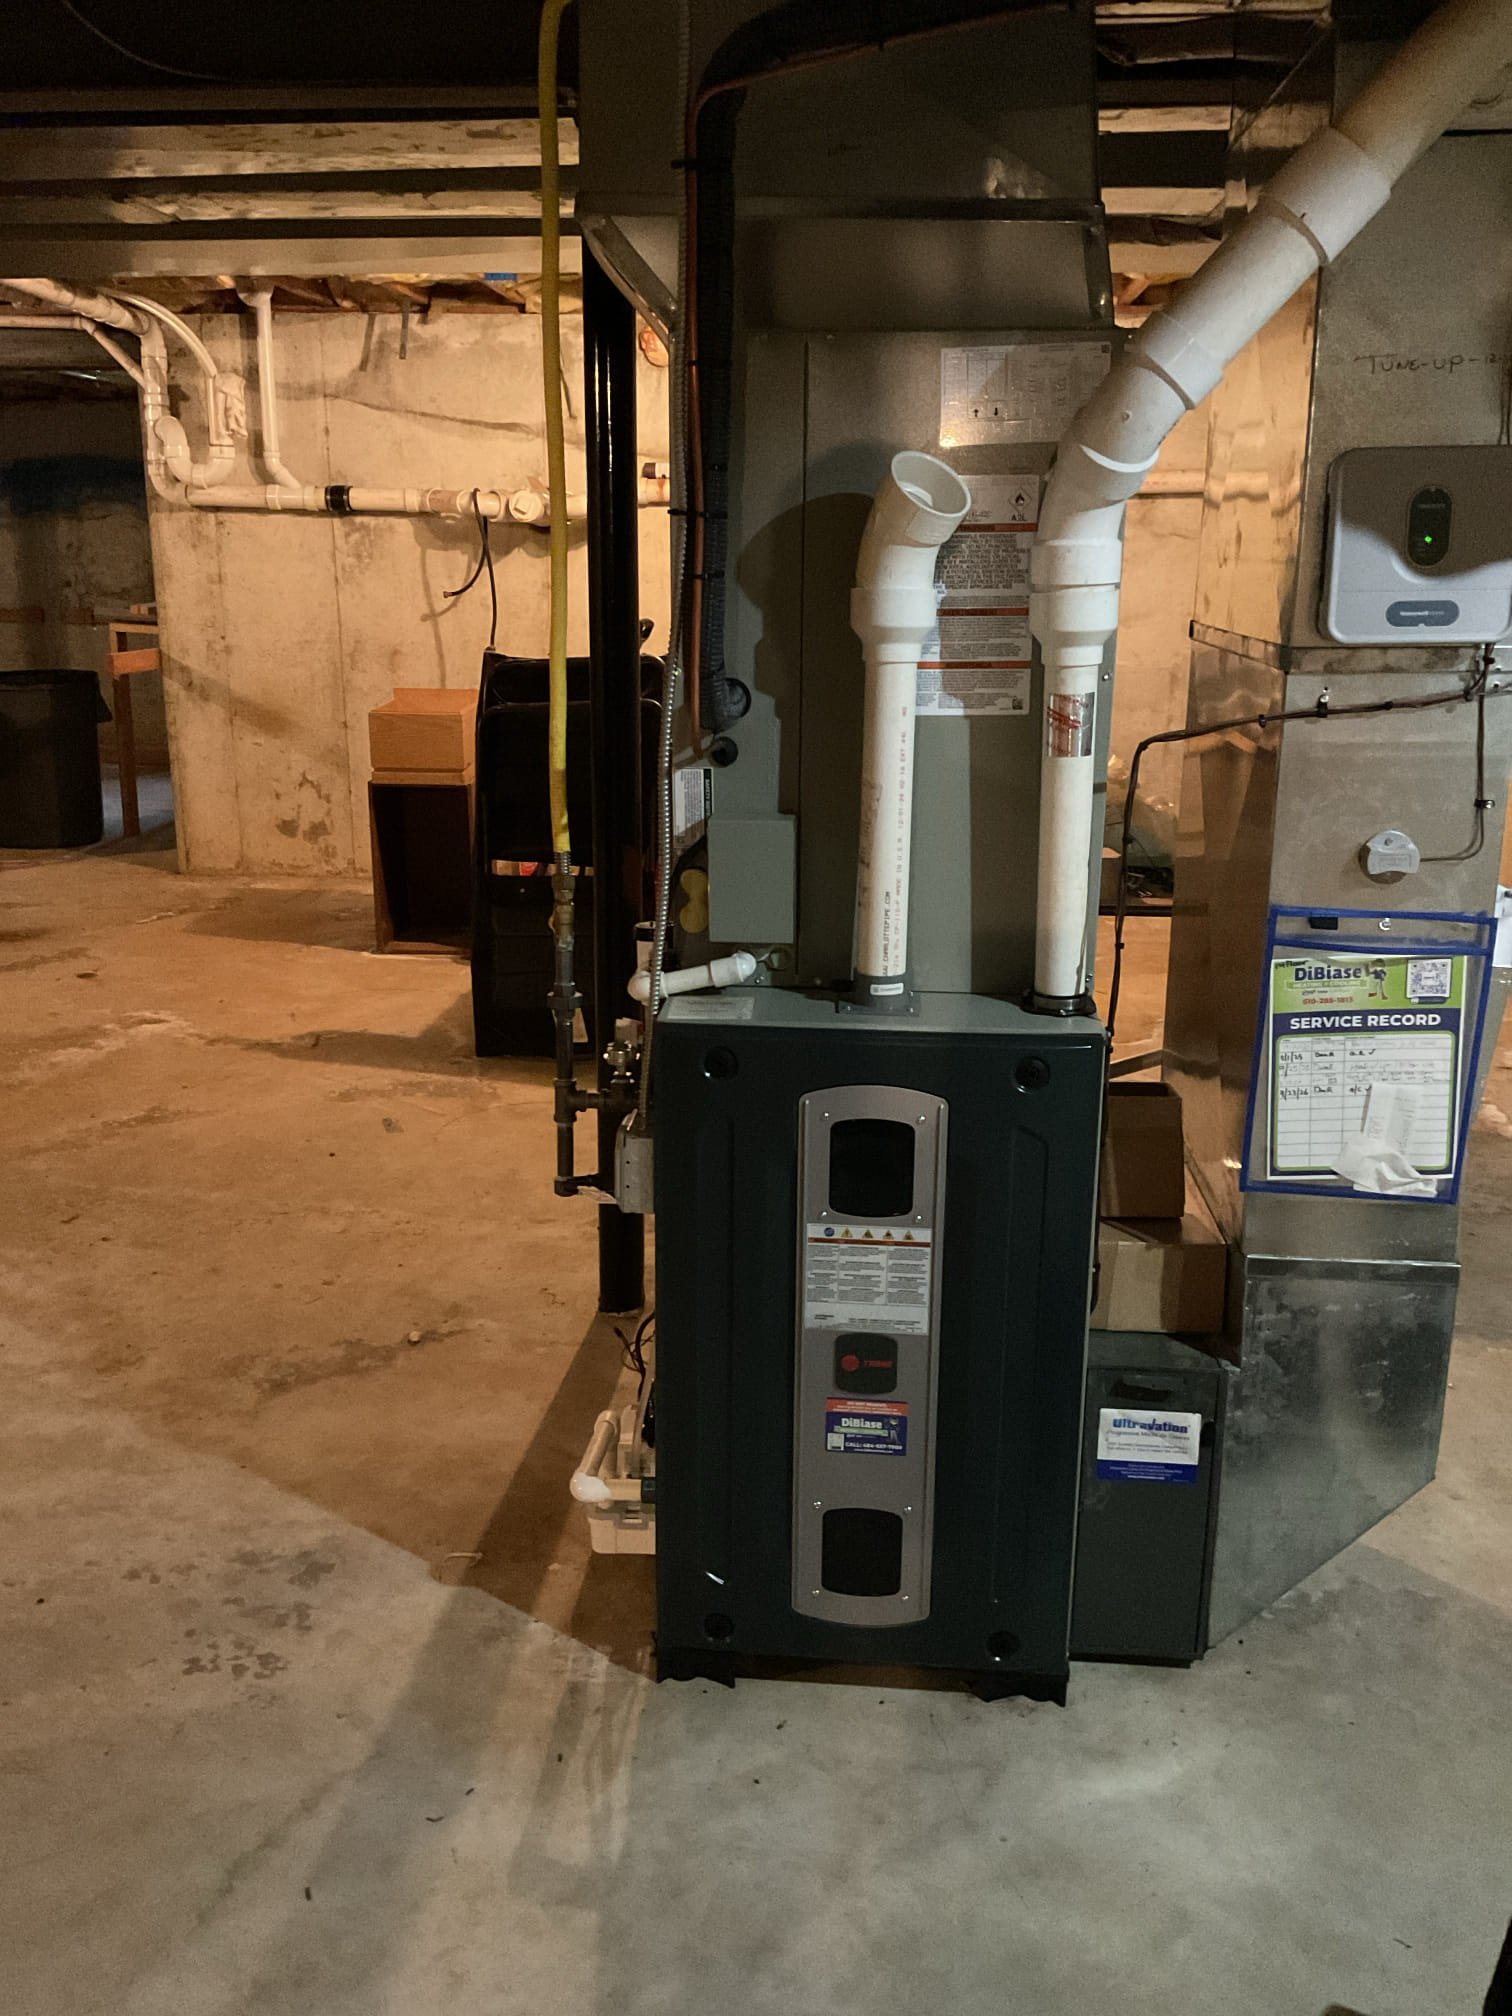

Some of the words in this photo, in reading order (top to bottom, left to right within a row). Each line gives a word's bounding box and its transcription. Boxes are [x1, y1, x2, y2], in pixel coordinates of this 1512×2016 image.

[1294, 965, 1362, 982] DiBiase
[1290, 1015, 1362, 1030] SERVICE
[1368, 1014, 1441, 1027] RECORD
[841, 1417, 883, 1429] DiBiase
[1113, 1418, 1188, 1434] ultravation
